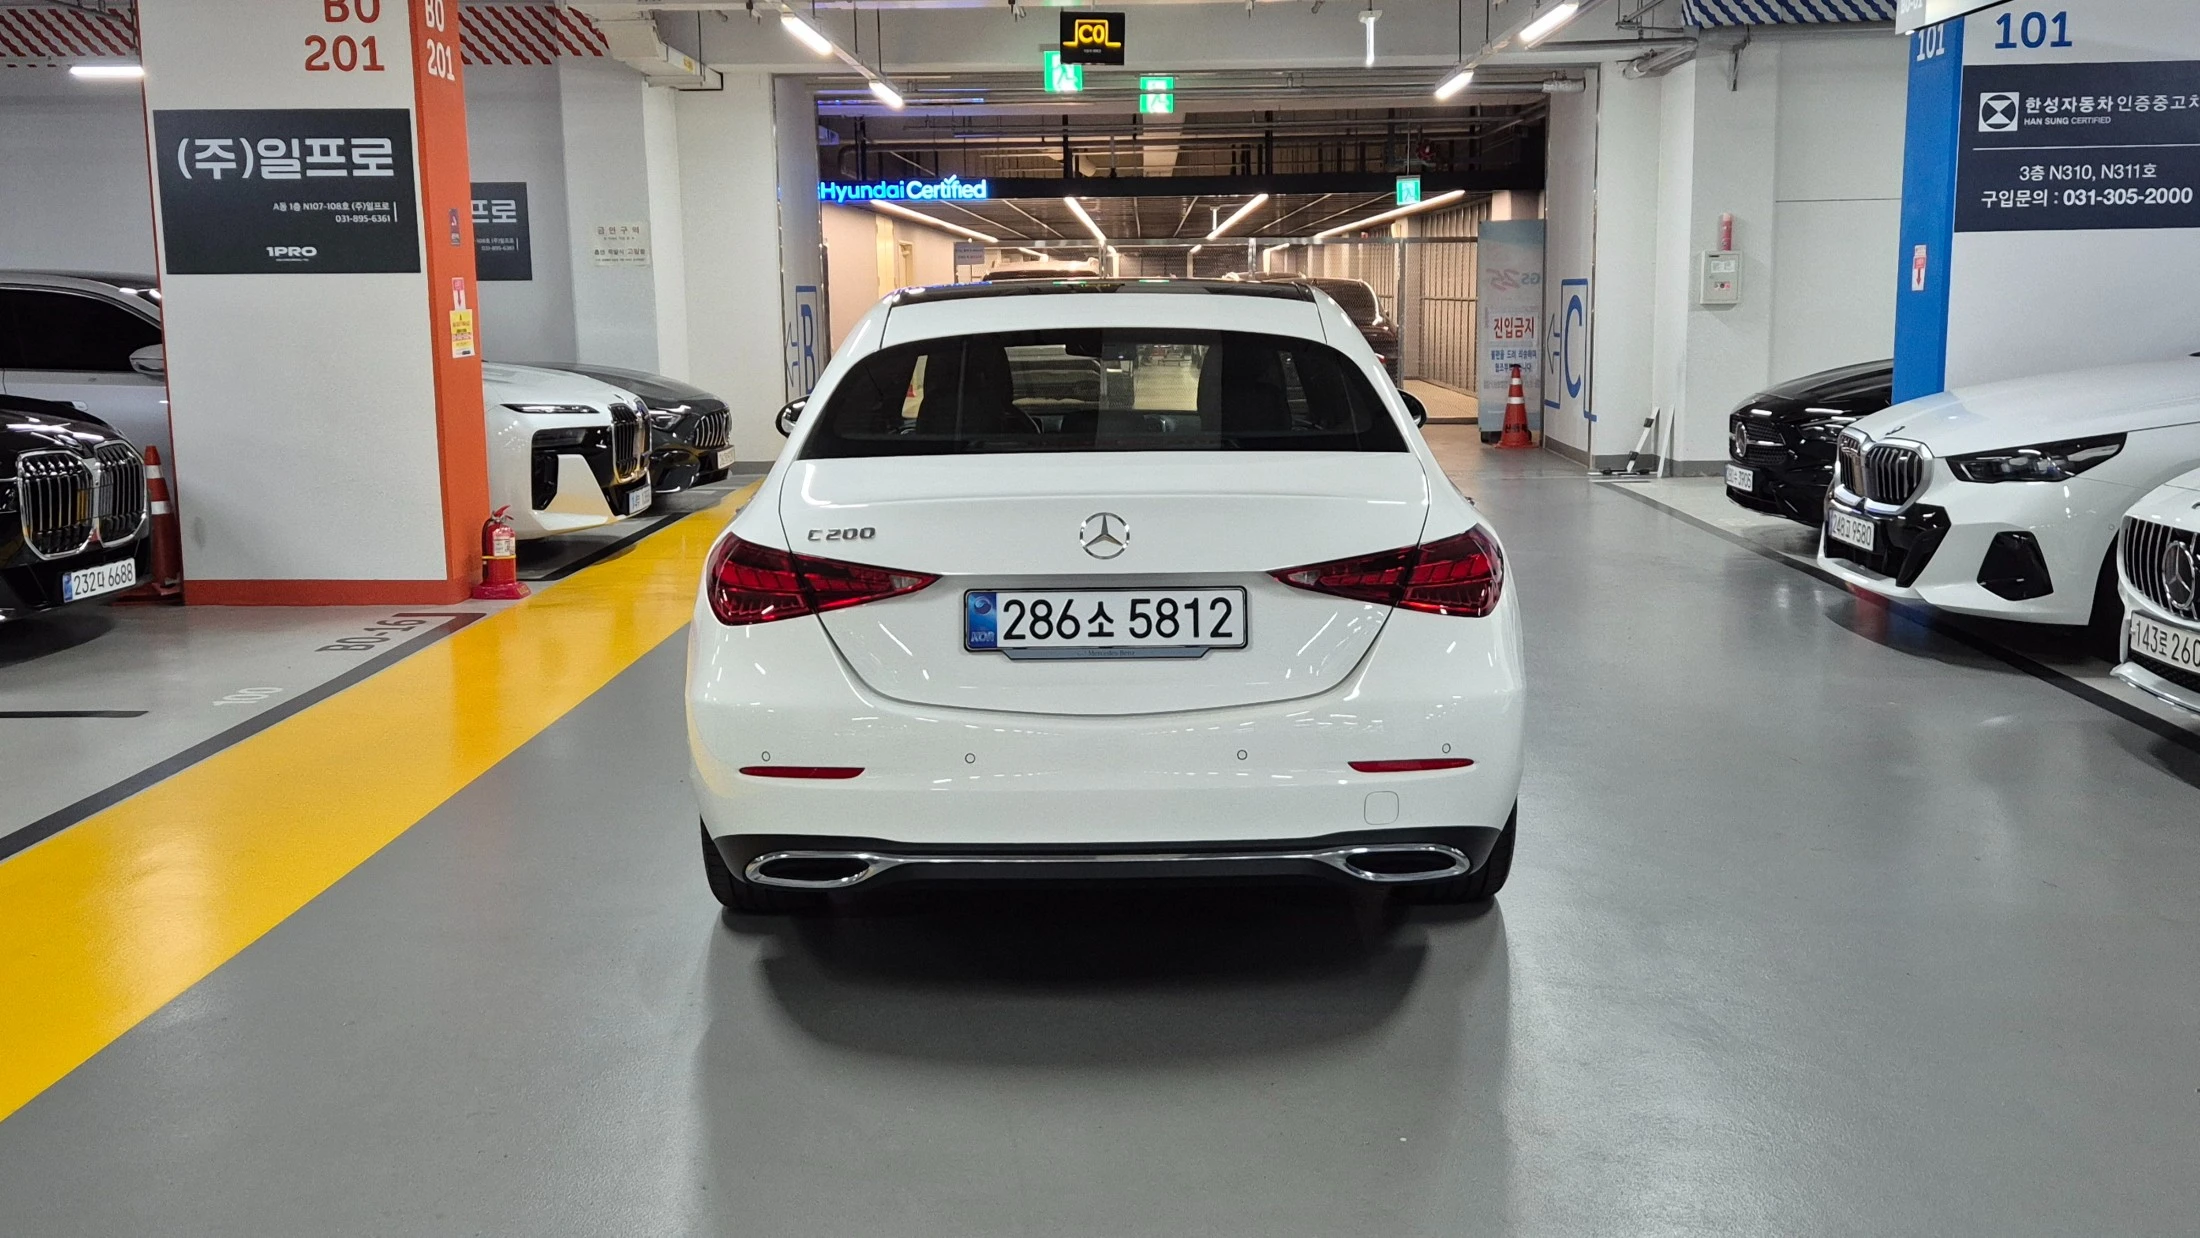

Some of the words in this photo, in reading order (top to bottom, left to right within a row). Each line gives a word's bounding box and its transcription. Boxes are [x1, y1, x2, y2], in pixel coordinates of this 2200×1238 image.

[1916, 24, 1945, 62] 101
[1994, 11, 2073, 49] 101
[304, 35, 385, 72] 201
[427, 38, 455, 82] 201
[2024, 117, 2043, 126] HAN
[2044, 116, 2070, 125] SUNG
[2071, 116, 2112, 125] CERTIFIED
[178, 137, 395, 180] (주)일프로
[2019, 164, 2045, 181] 3층
[2049, 164, 2096, 182] N310,
[2101, 162, 2158, 179] N311호
[820, 181, 905, 203] Hyundai
[906, 174, 987, 199] Certified
[1981, 189, 2048, 208] 구입문의
[2063, 187, 2193, 206] 031-305-2000
[335, 214, 391, 223] 031-895-6361
[266, 246, 317, 257] 1PRO
[1493, 316, 1535, 339] 진입금지
[1564, 294, 1583, 399] C
[807, 528, 823, 542] C
[826, 526, 876, 541] 200
[1852, 520, 1872, 546] 9580
[107, 562, 134, 587] 6688
[1003, 598, 1115, 640] 286소
[1128, 597, 1234, 639] 5812
[2136, 619, 2168, 657] 143로
